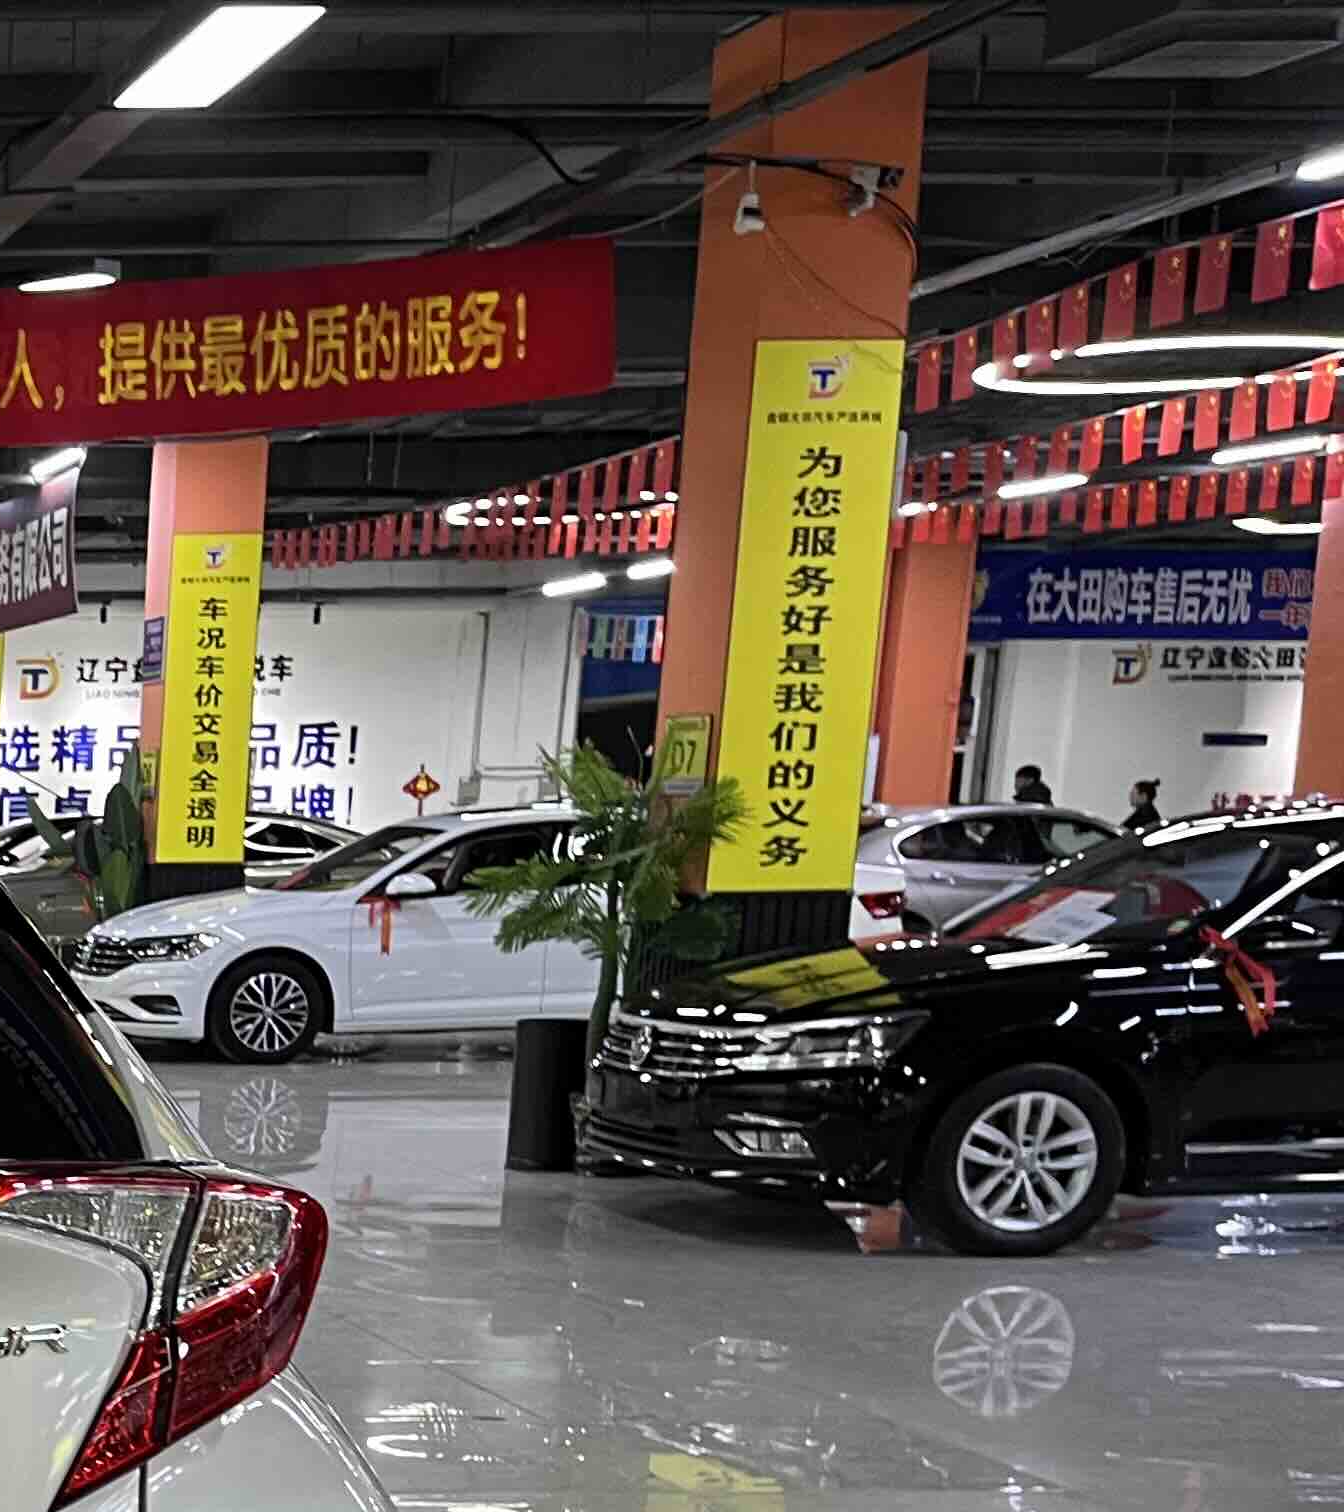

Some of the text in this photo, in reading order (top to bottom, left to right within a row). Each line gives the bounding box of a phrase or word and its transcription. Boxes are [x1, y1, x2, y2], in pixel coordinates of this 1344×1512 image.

[759, 445, 843, 868] 为您服务好是我们的义务
[1026, 566, 1255, 625] 在大田购车售后无忧
[185, 597, 229, 849] 车况车价交易全透明
